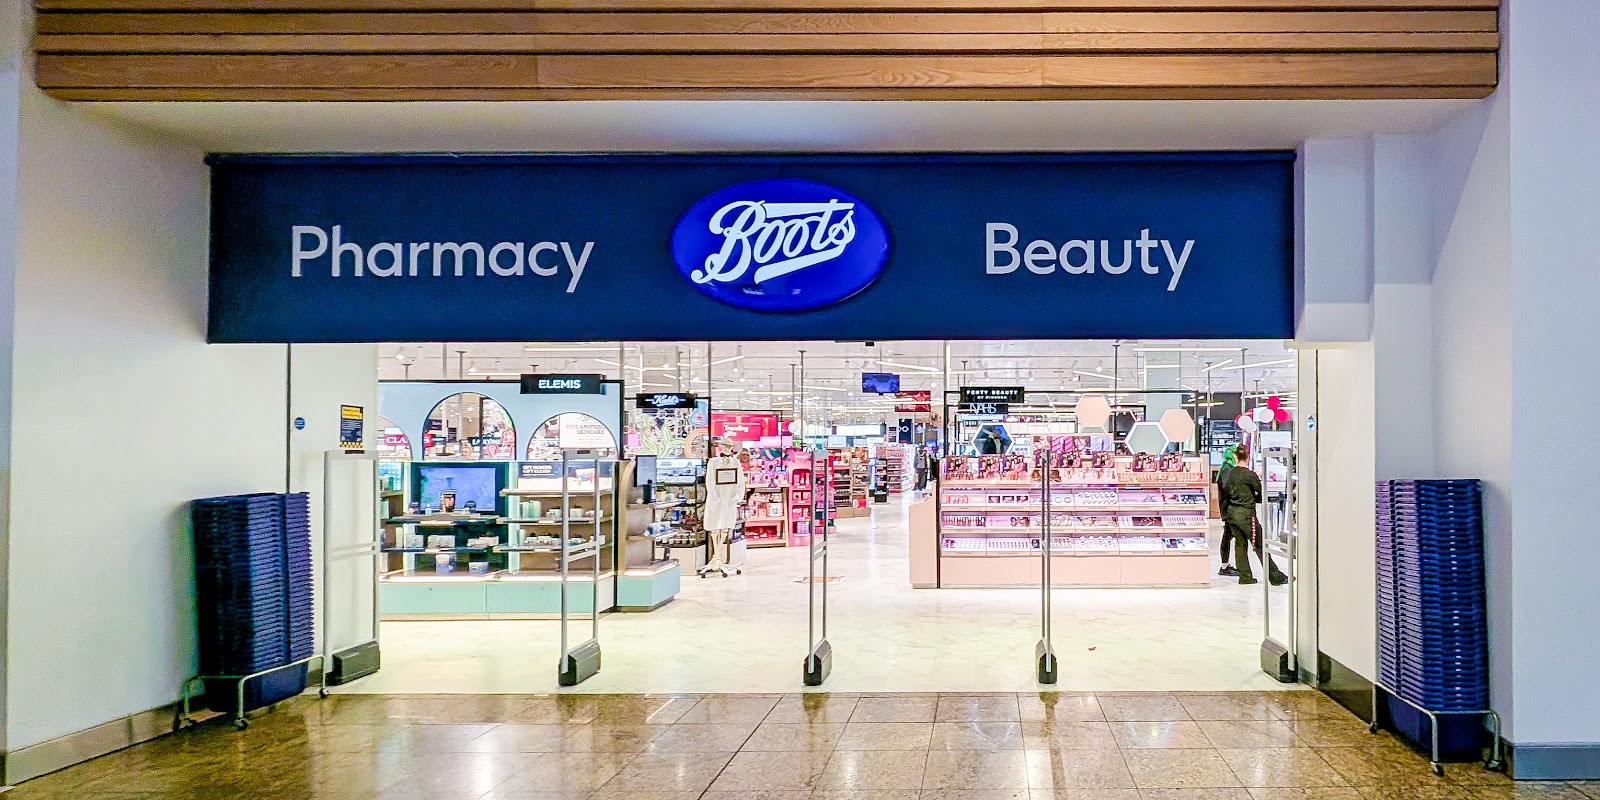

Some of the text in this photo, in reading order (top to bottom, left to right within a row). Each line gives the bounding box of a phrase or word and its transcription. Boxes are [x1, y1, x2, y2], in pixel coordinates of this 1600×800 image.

[291, 225, 595, 293] Pharmacy
[691, 199, 856, 284] Boots
[986, 222, 1196, 292] Beauty
[538, 379, 581, 389] ELEMIS
[724, 424, 749, 432] Trending
[969, 403, 997, 414] NARS
